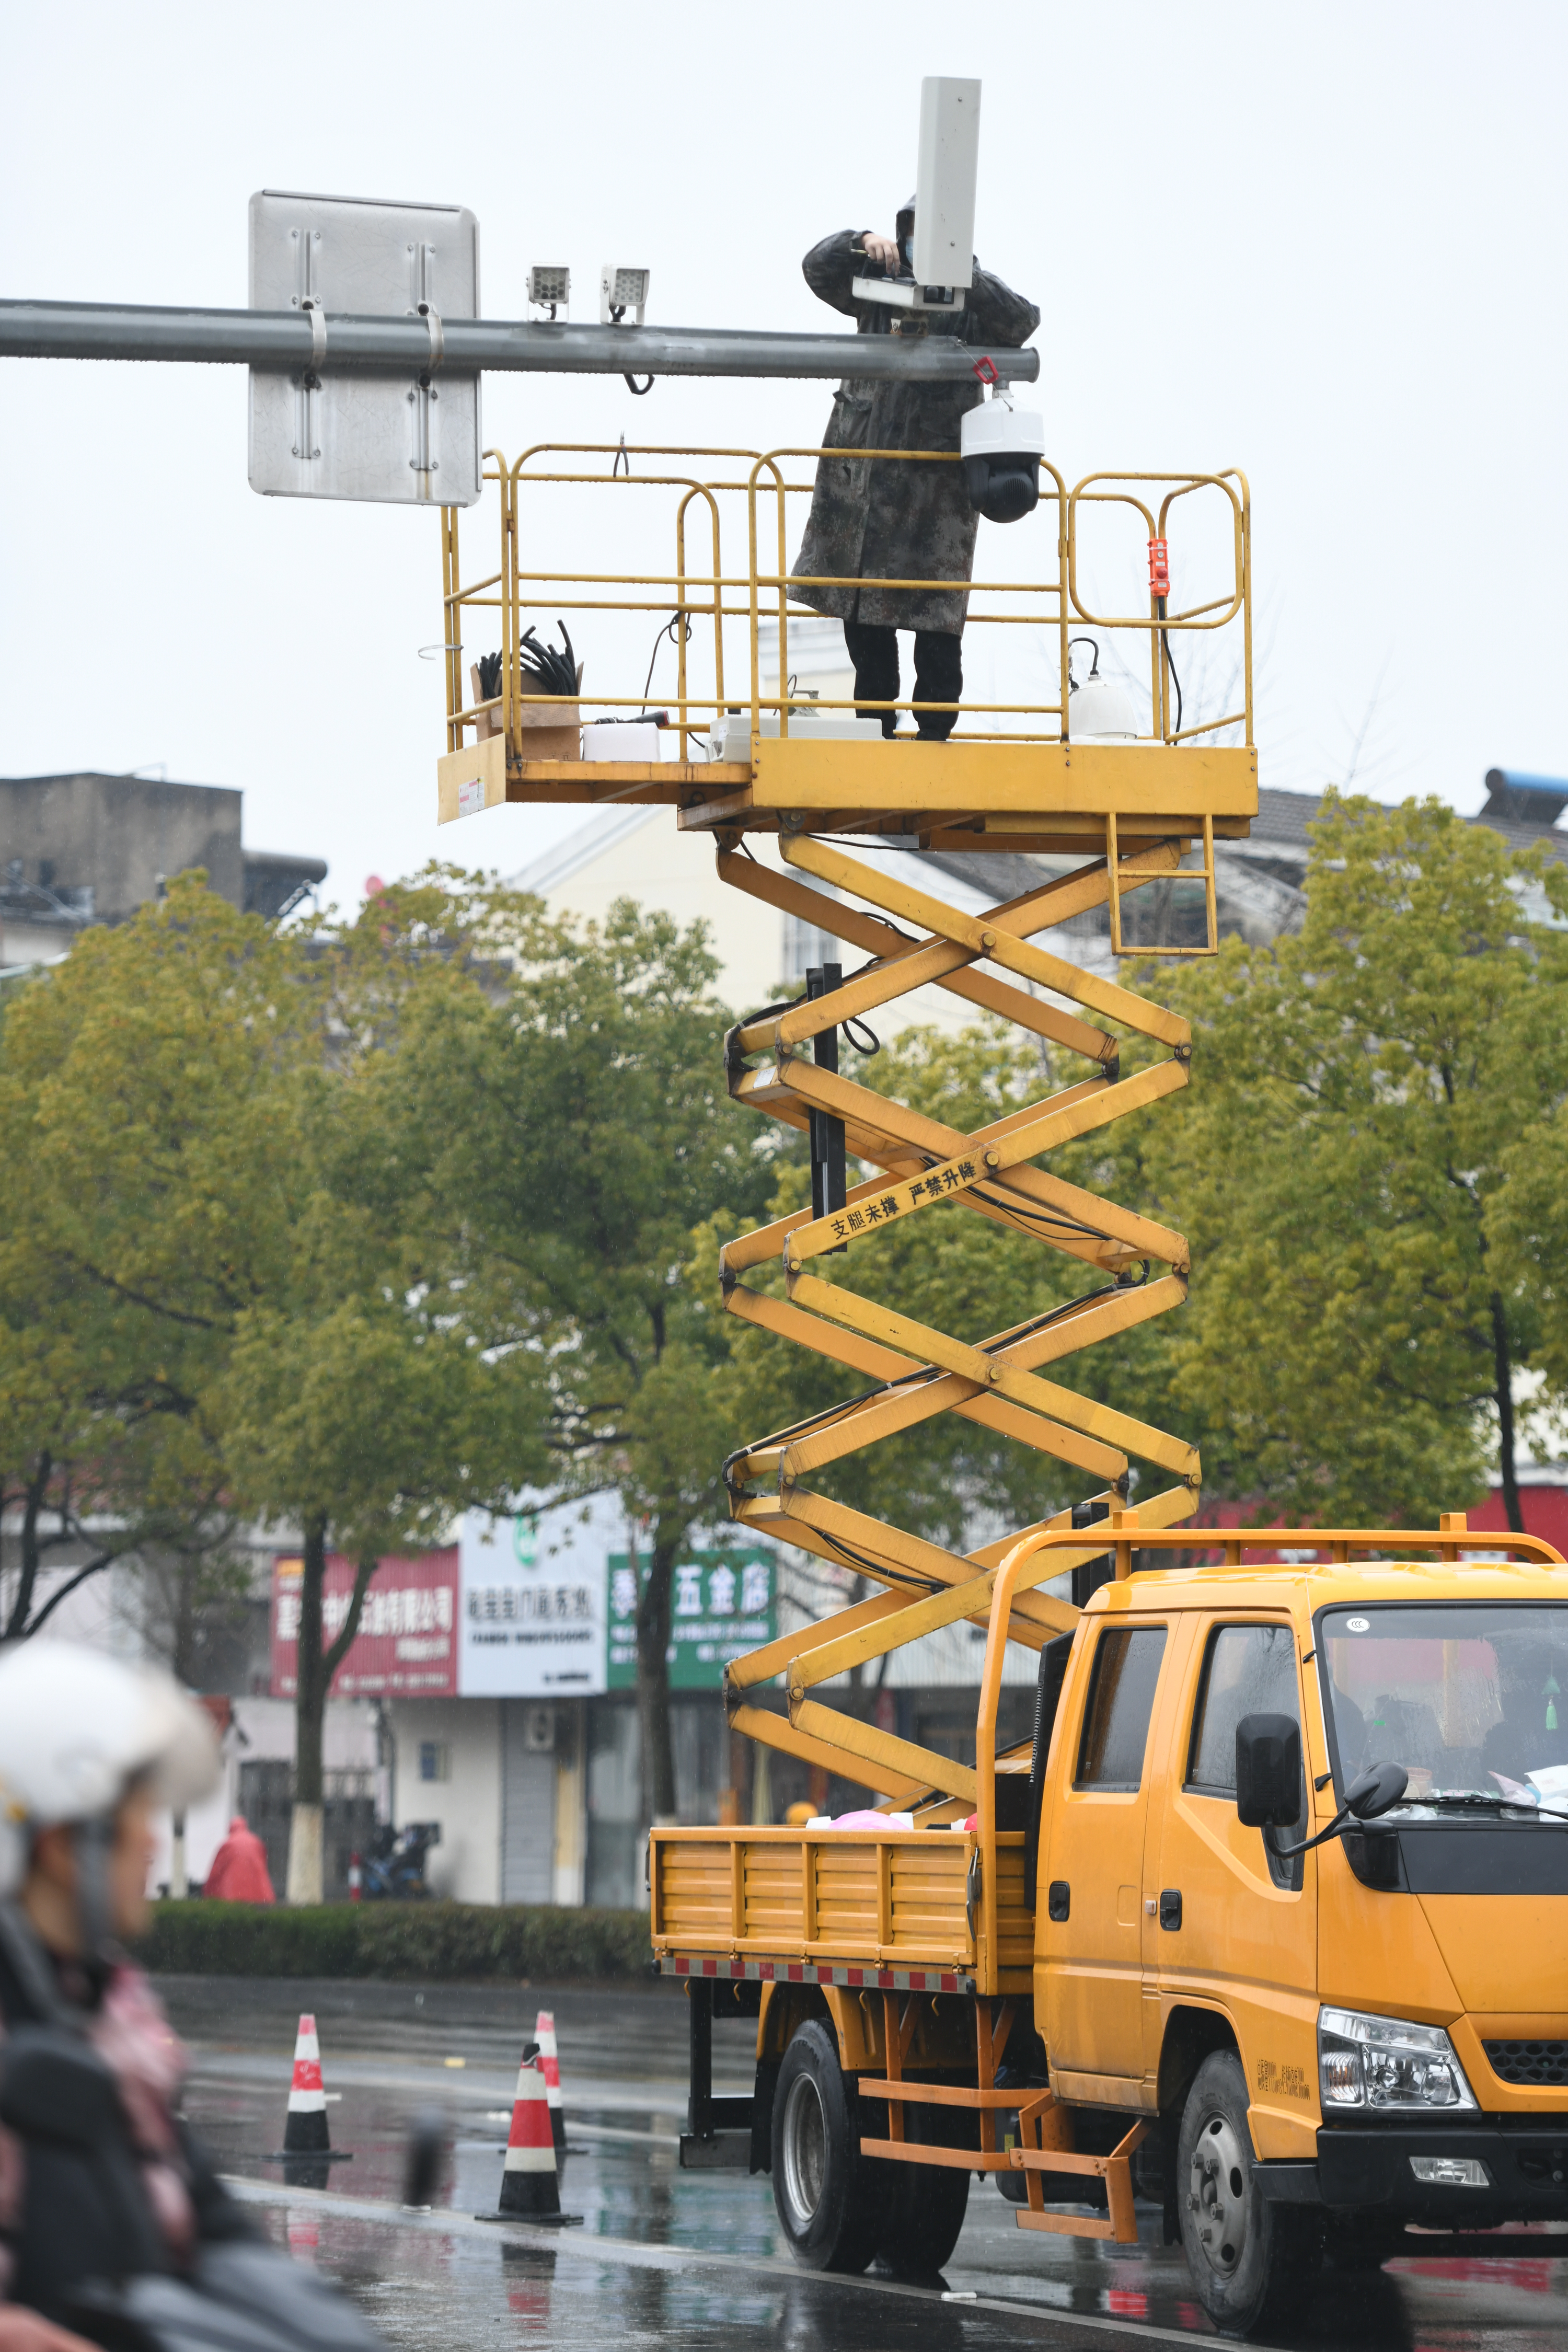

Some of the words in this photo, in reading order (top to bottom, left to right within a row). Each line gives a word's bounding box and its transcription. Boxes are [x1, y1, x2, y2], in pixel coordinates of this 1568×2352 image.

[831, 1195, 899, 1240] 支腿未撑
[908, 1161, 976, 1205] 严禁升降
